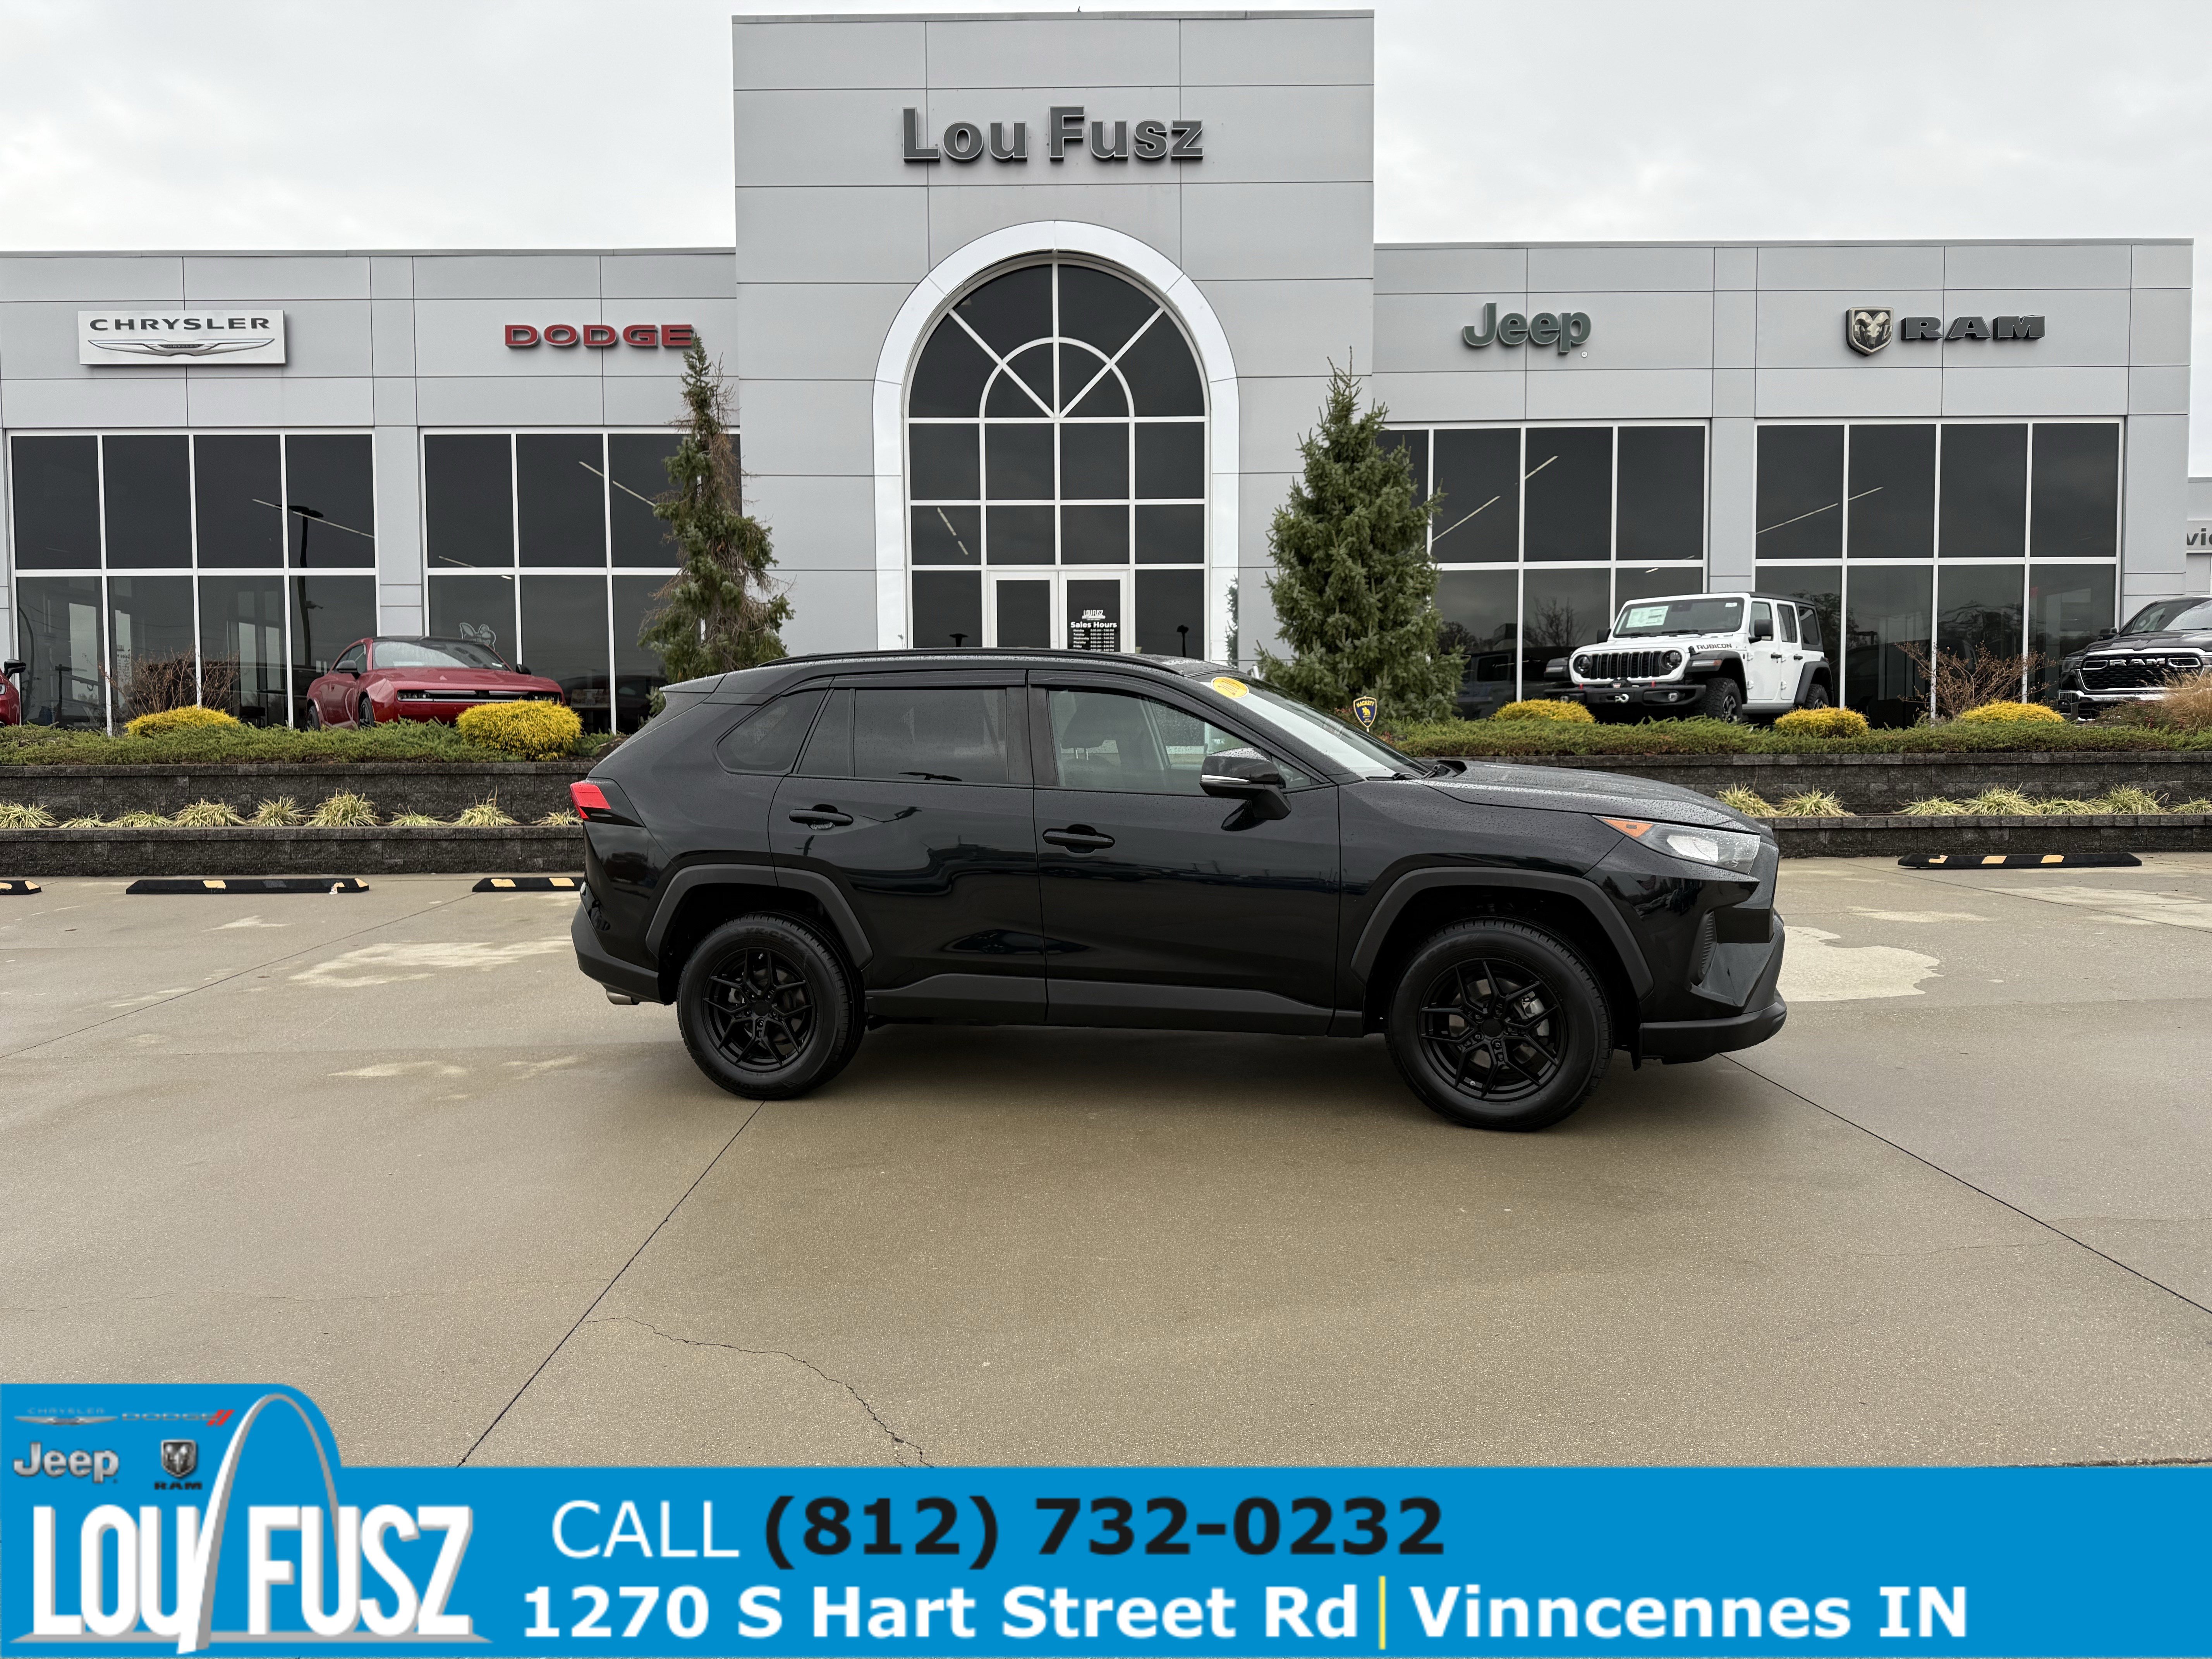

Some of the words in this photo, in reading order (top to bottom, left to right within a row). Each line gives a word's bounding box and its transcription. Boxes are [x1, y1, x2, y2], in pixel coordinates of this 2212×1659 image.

[902, 107, 1027, 163] Lou
[1048, 105, 1205, 161] Fusz
[89, 318, 270, 331] CHRYSLER
[505, 324, 694, 347] DODGE
[1463, 302, 1592, 354] Jeep
[1901, 315, 2045, 340] RAM
[2186, 528, 2212, 546] vi
[2110, 658, 2165, 666] RAM
